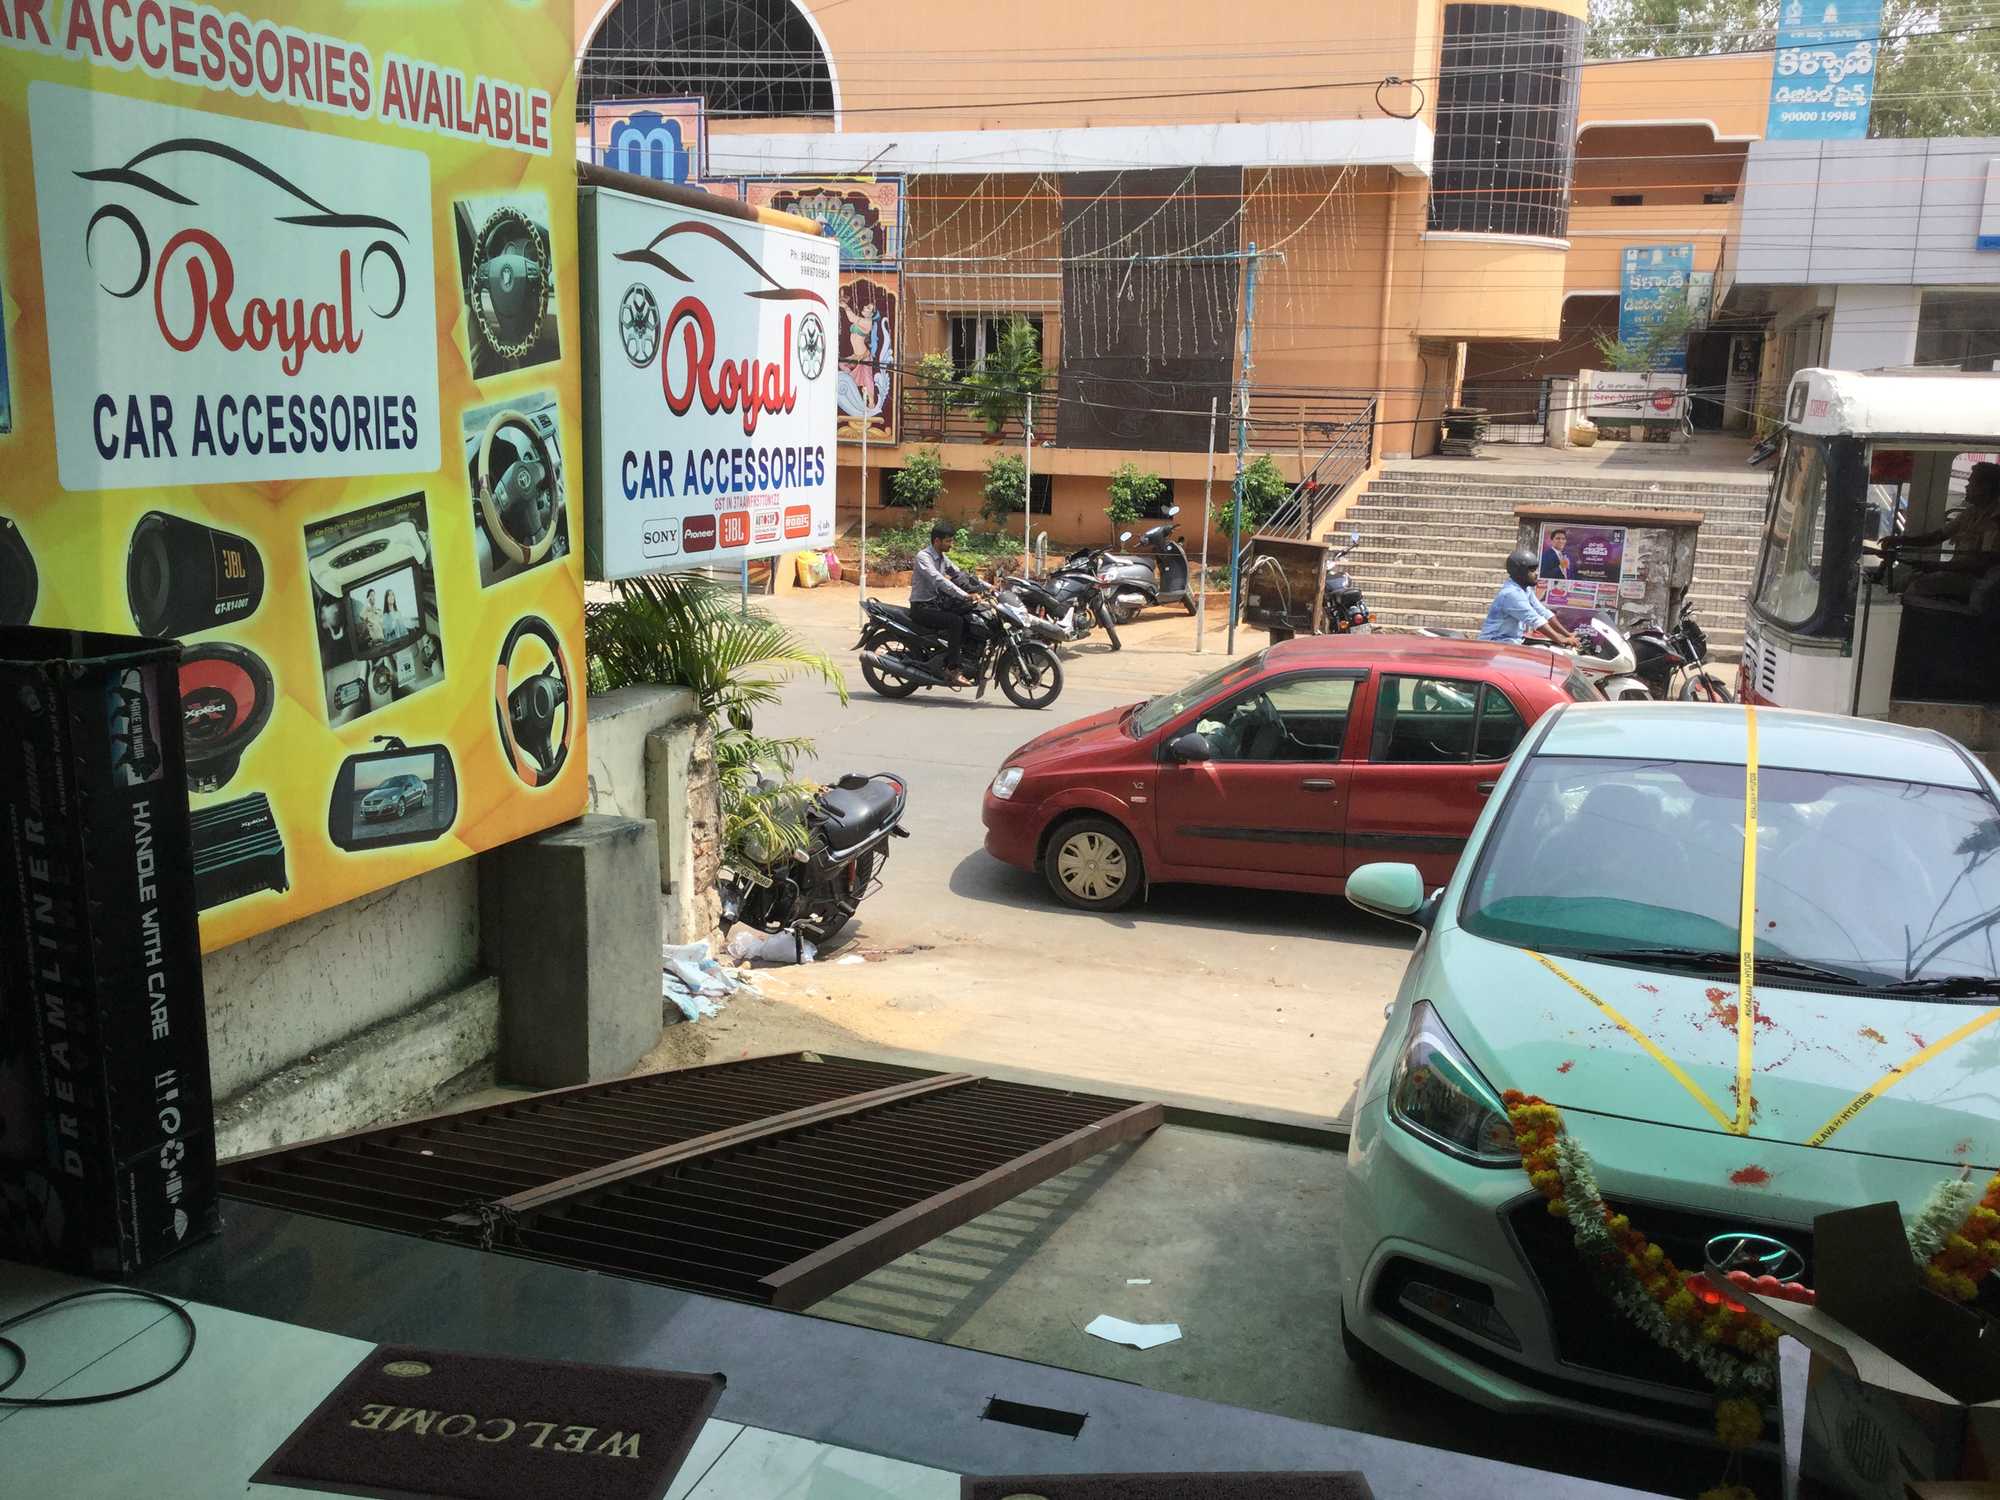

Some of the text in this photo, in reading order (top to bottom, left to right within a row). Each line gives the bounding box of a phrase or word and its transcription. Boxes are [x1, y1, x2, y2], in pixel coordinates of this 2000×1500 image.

[66, 0, 371, 112] ACCESSORIES
[382, 60, 549, 150] AVAILABLE
[1781, 110, 1857, 123] 90000 19988
[153, 228, 364, 378] Royal
[661, 295, 797, 437] Royal
[93, 393, 418, 461] CAR ACCESSORIES
[622, 446, 825, 500] CAR ACCESSORIES
[643, 529, 678, 545] SONY
[685, 528, 715, 540] Pioneer
[724, 518, 744, 542] JBL
[223, 549, 246, 578] JBL
[130, 697, 145, 760] MAKE IN INDIA
[132, 799, 171, 1041] HANDLE WITH CARE
[23, 815, 85, 1179] DREAMLINER
[350, 1403, 641, 1460] WELCOME
